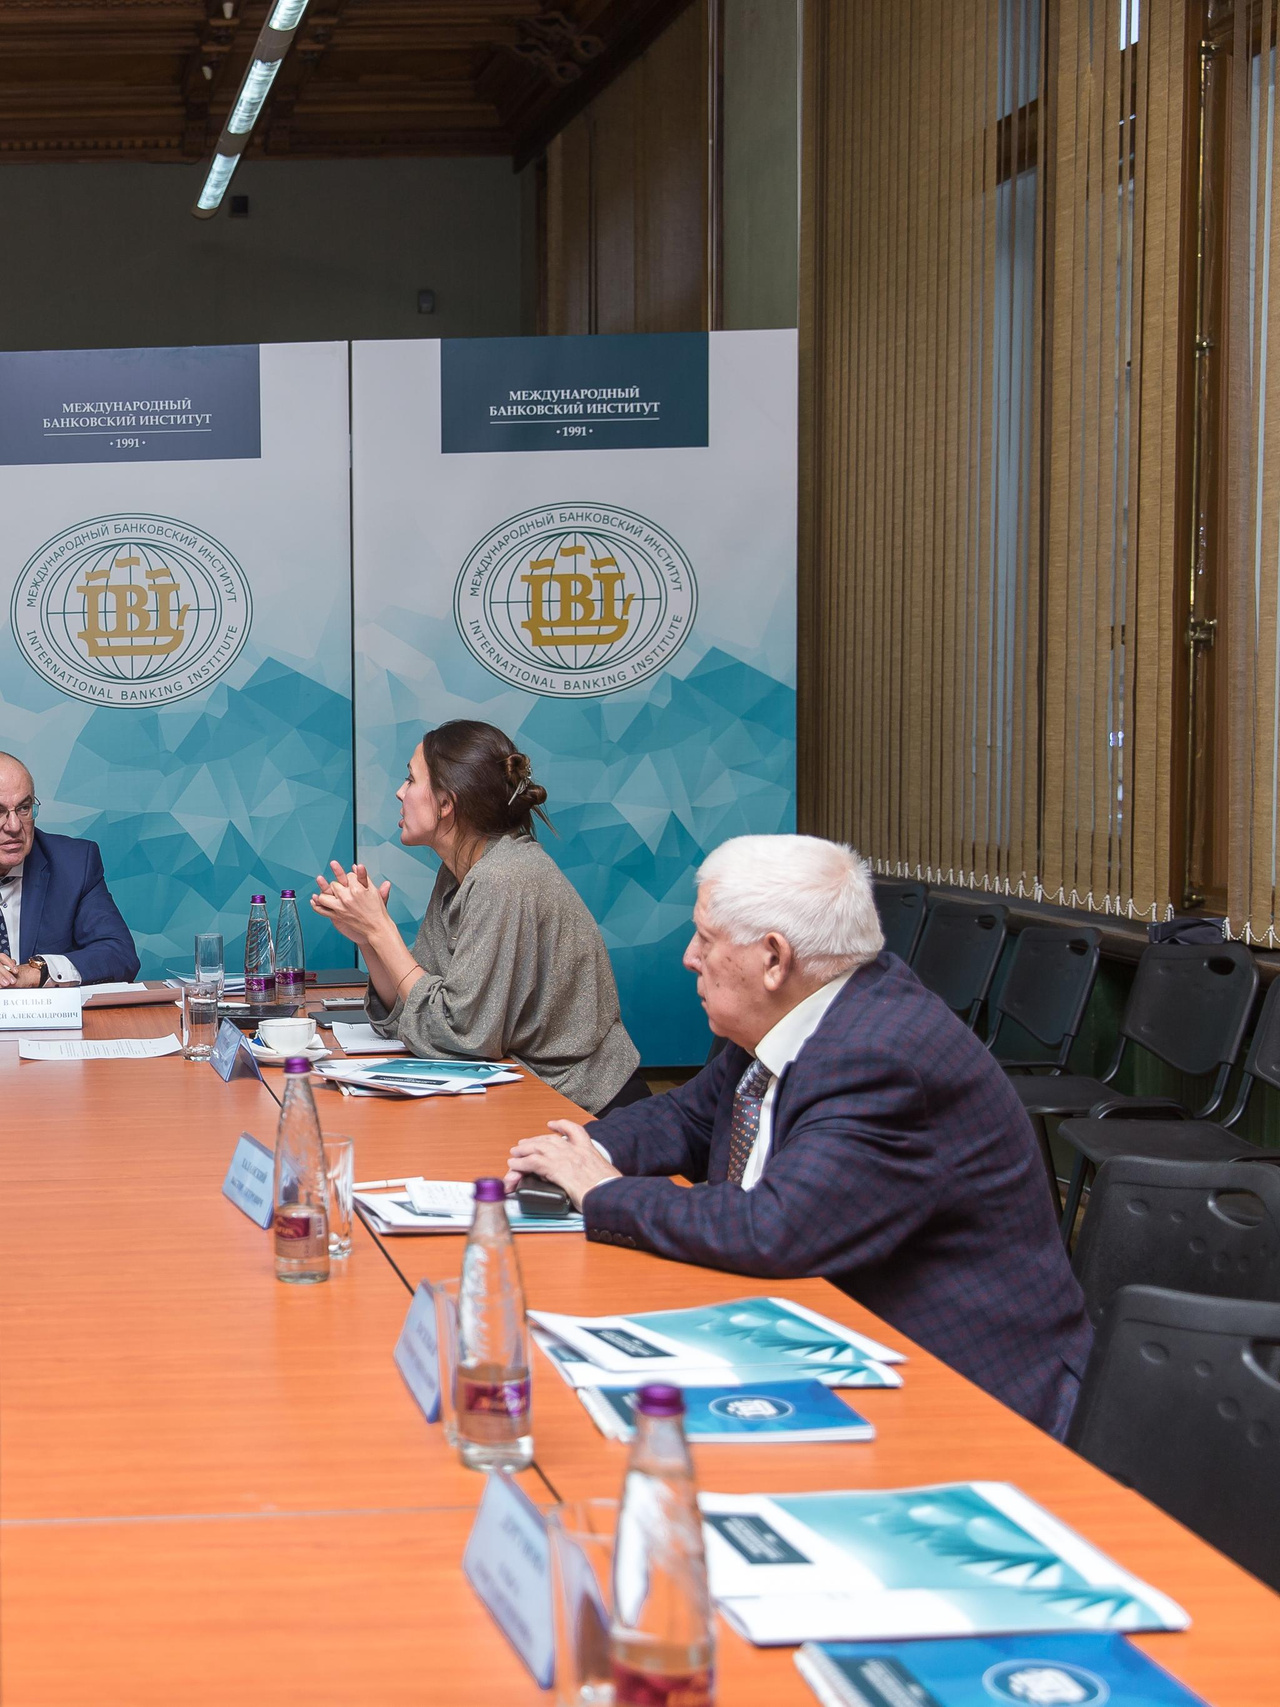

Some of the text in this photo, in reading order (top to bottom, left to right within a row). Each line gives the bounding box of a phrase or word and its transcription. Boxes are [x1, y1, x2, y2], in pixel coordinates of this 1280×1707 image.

[509, 386, 640, 402] МЕЖДУНАРОДНЫЙ
[62, 398, 192, 414] МЕЖДУНАРОДНЫЙ
[489, 402, 660, 416] БАНКОВСКИЙ ИНСТИТУТ
[43, 414, 212, 428] БАНКОВСКИЙ ИНСТИТУТ
[562, 426, 587, 437] 1991
[116, 438, 140, 448] 1991
[470, 512, 682, 597] МЕЖДУНАРОДНЫЙ БАНКОВСКИЙ ИНСТИТУТ
[26, 523, 237, 608] МЕЖДУНАРОДНЫЙ БАНКОВСКИЙ ИНСТИТУТ
[470, 614, 682, 690] INTERNATIONAL BANKING INSTITUTE
[26, 625, 238, 700] INTERNATIONAL BANKING INSTITUTE
[3, 998, 52, 1006] ВАСИЛЬЕВ
[10, 1012, 78, 1020] АЛЕКСАНДРОВИЧ
